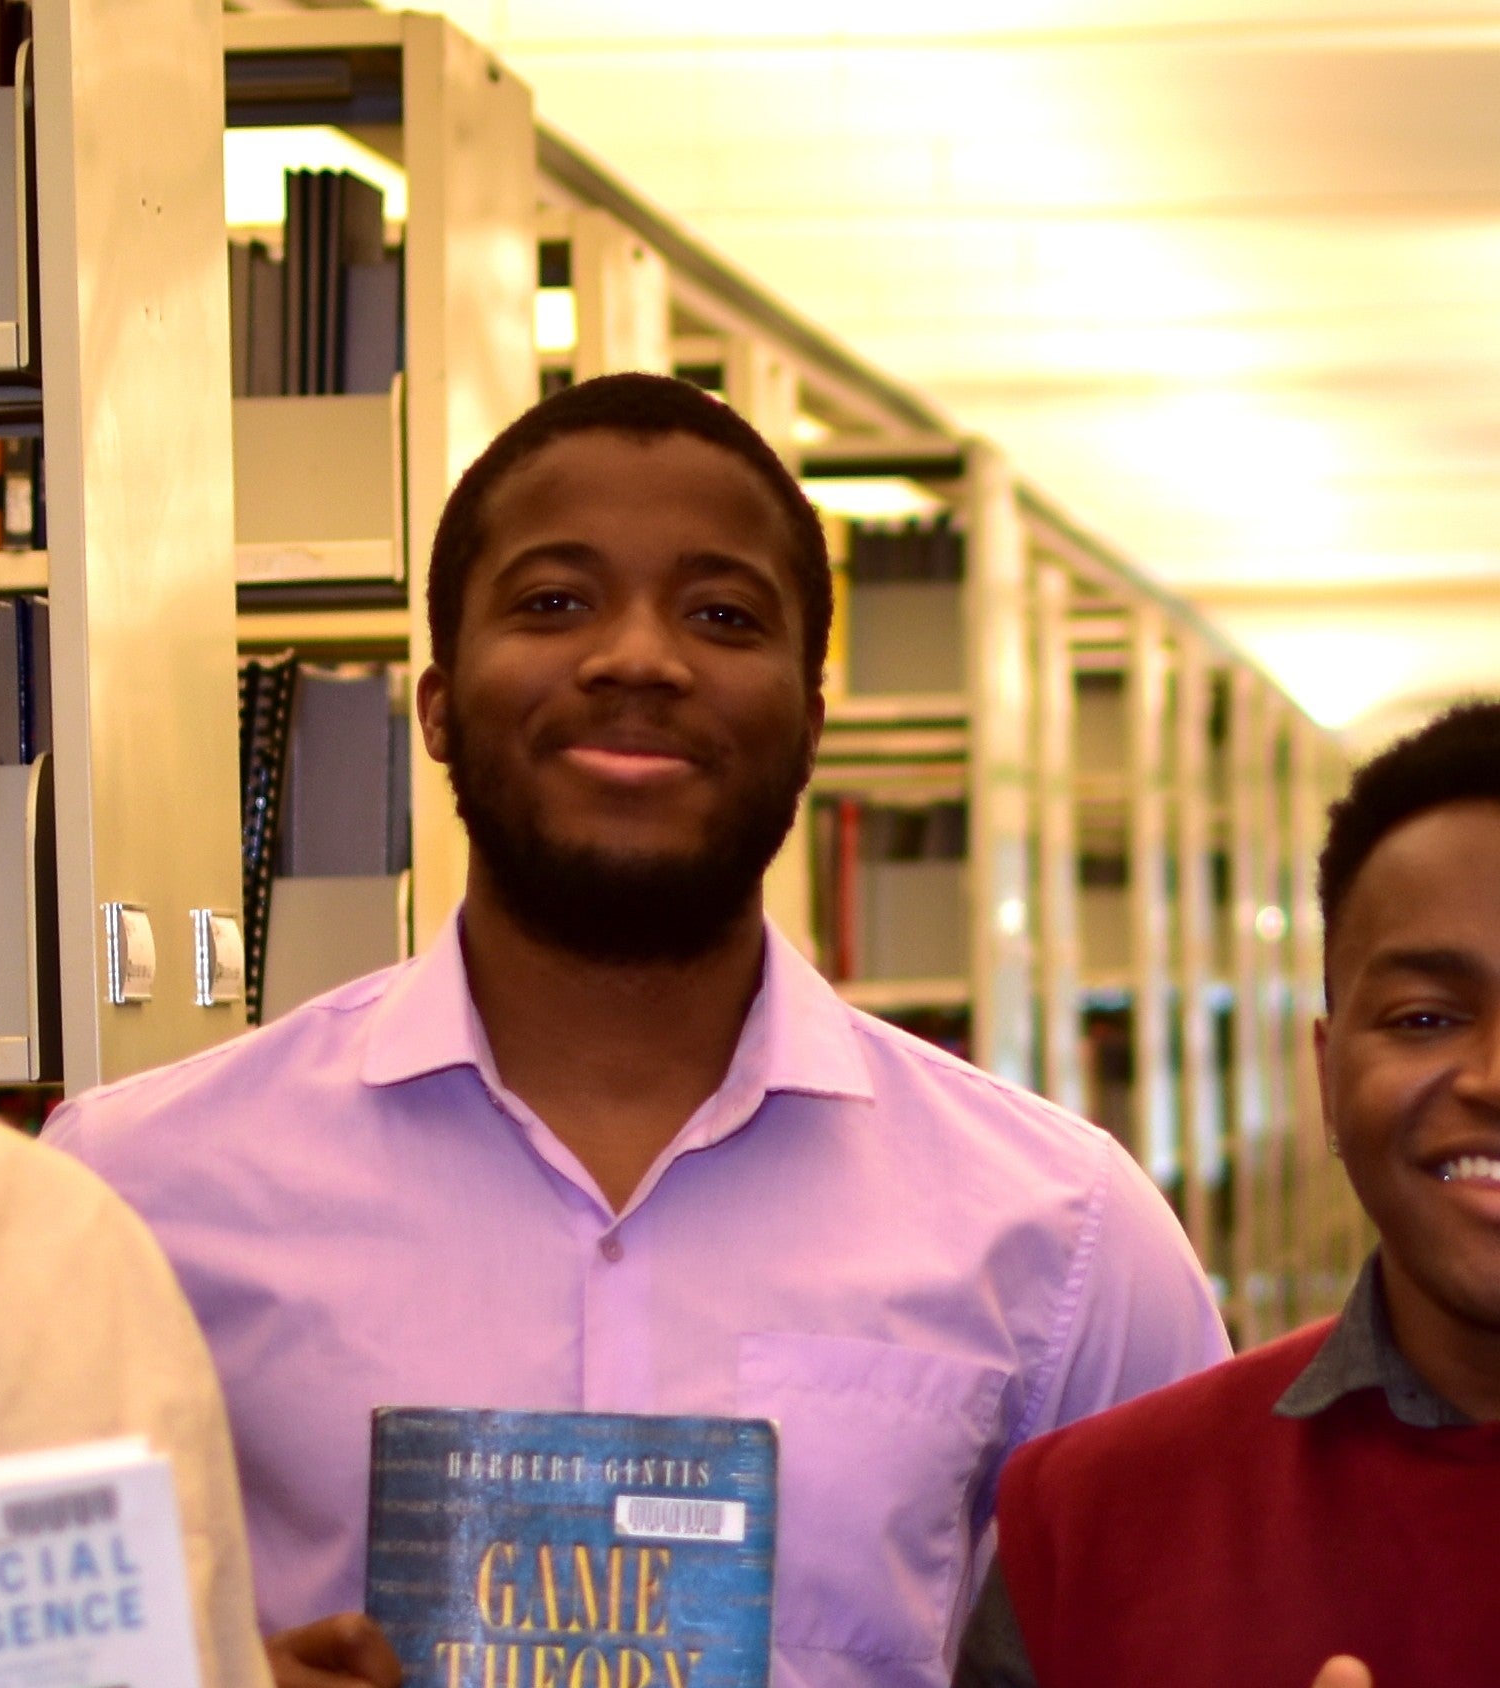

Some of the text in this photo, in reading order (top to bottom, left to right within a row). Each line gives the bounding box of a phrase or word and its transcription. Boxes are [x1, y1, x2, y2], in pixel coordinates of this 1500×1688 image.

[447, 1451, 712, 1488] HERBERT GINTIS
[475, 1539, 672, 1637] GAME
